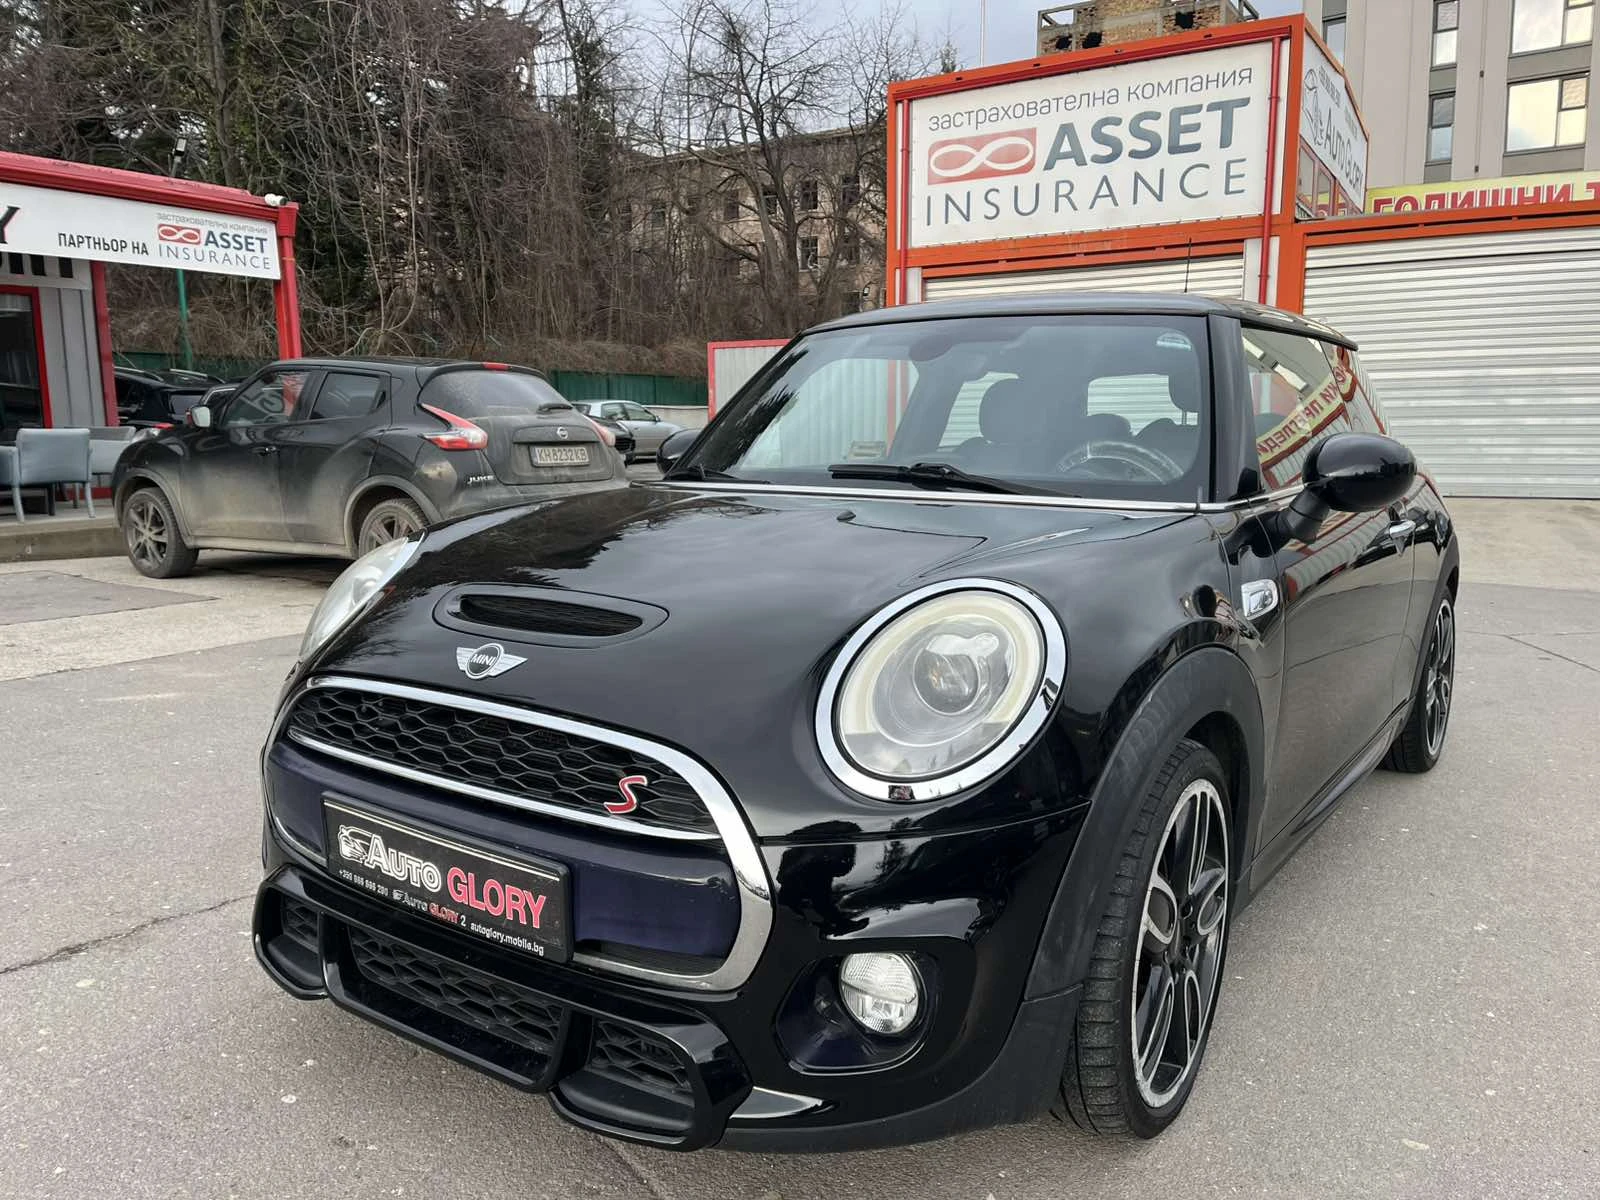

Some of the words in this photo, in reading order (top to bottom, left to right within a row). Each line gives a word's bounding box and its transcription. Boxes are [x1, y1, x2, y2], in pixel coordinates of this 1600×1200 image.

[928, 88, 1119, 132] застрахователна
[1127, 67, 1253, 100] компания
[1043, 97, 1251, 171] ASSET
[926, 158, 1248, 227] INSURANCE
[58, 233, 128, 253] ПАРТНЬОР
[131, 240, 149, 256] НА
[158, 243, 271, 270] INSURANCE
[204, 230, 268, 253] ASSET
[471, 653, 497, 666] MINI
[603, 775, 648, 814] S
[428, 902, 459, 924] GLORY
[460, 914, 467, 928] 2
[446, 866, 547, 929] GLORY
[470, 922, 545, 957] autoglory.mobile.bg
